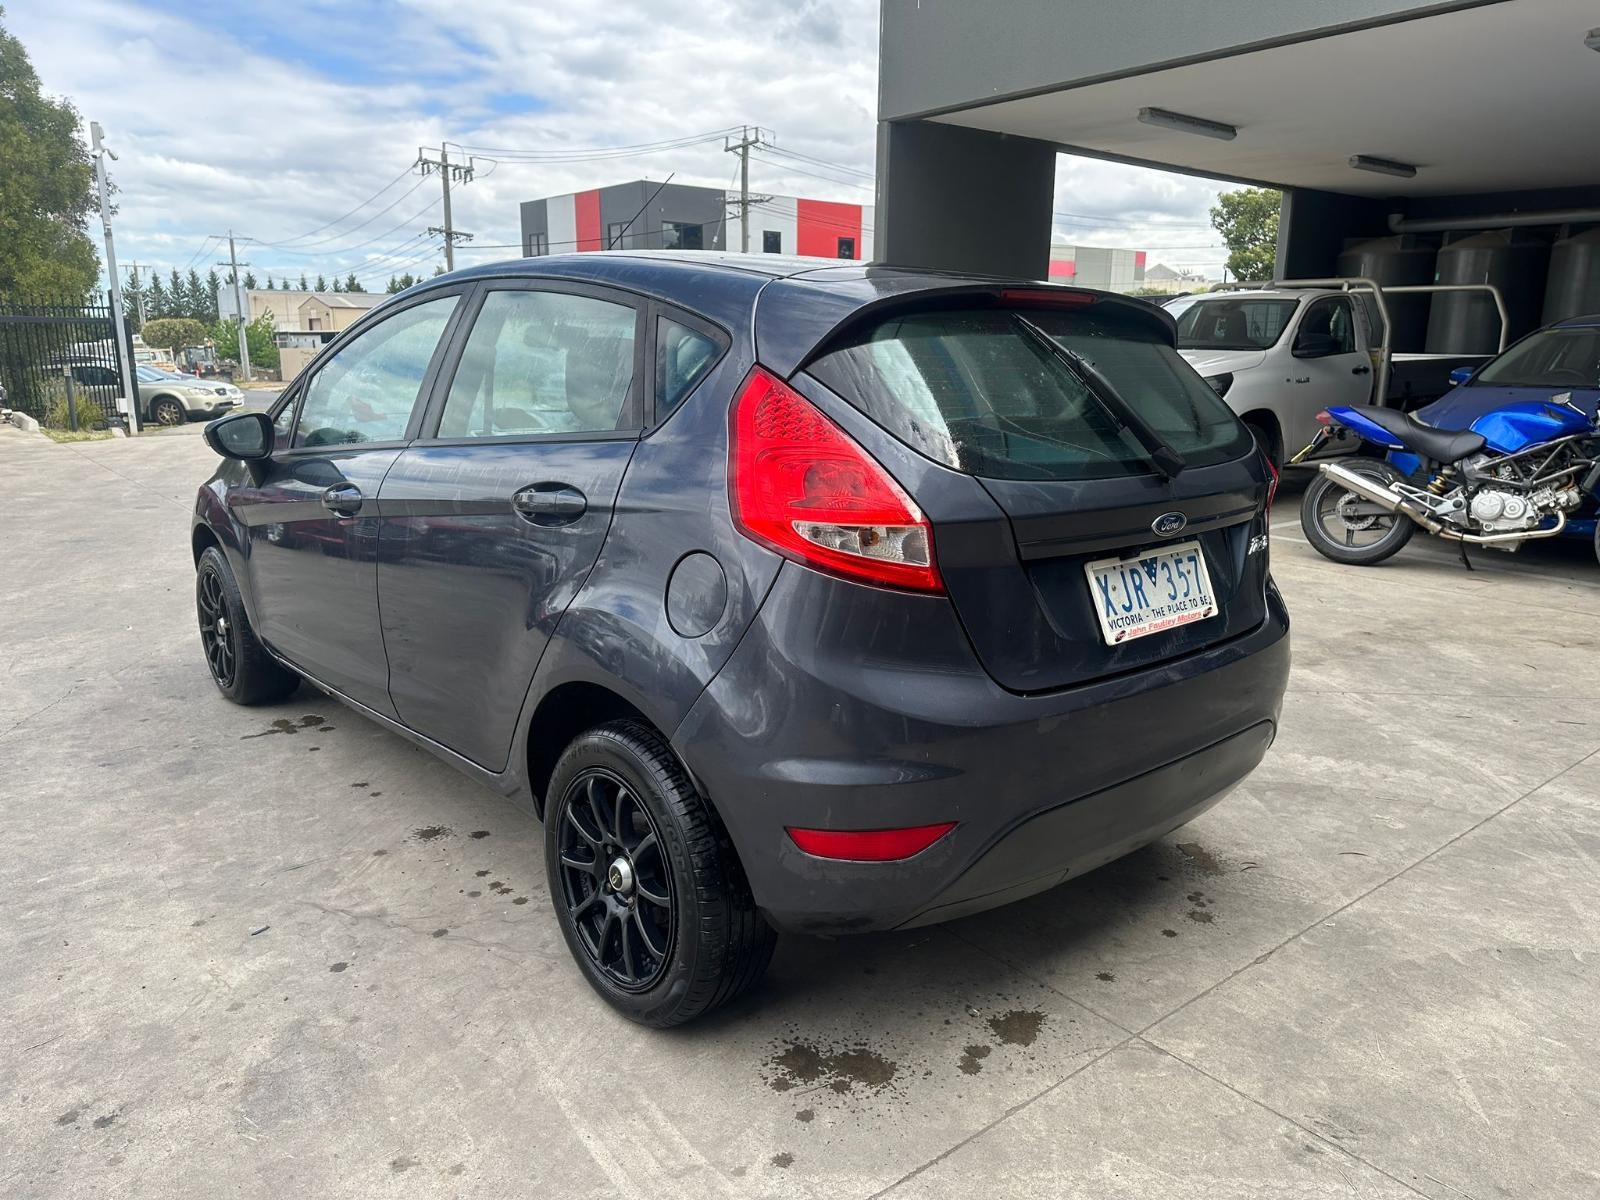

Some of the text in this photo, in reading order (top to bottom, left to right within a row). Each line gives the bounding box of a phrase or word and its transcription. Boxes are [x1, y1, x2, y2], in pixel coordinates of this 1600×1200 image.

[1161, 516, 1180, 531] Ford
[1161, 556, 1202, 601] 357
[1108, 613, 1144, 630] VICTORIA
[1151, 607, 1165, 618] THE
[1168, 601, 1188, 613] PLACE
[1188, 598, 1198, 609] TO
[1199, 595, 1209, 606] BE
[1128, 626, 1147, 637] John
[1177, 611, 1202, 624] Motors
